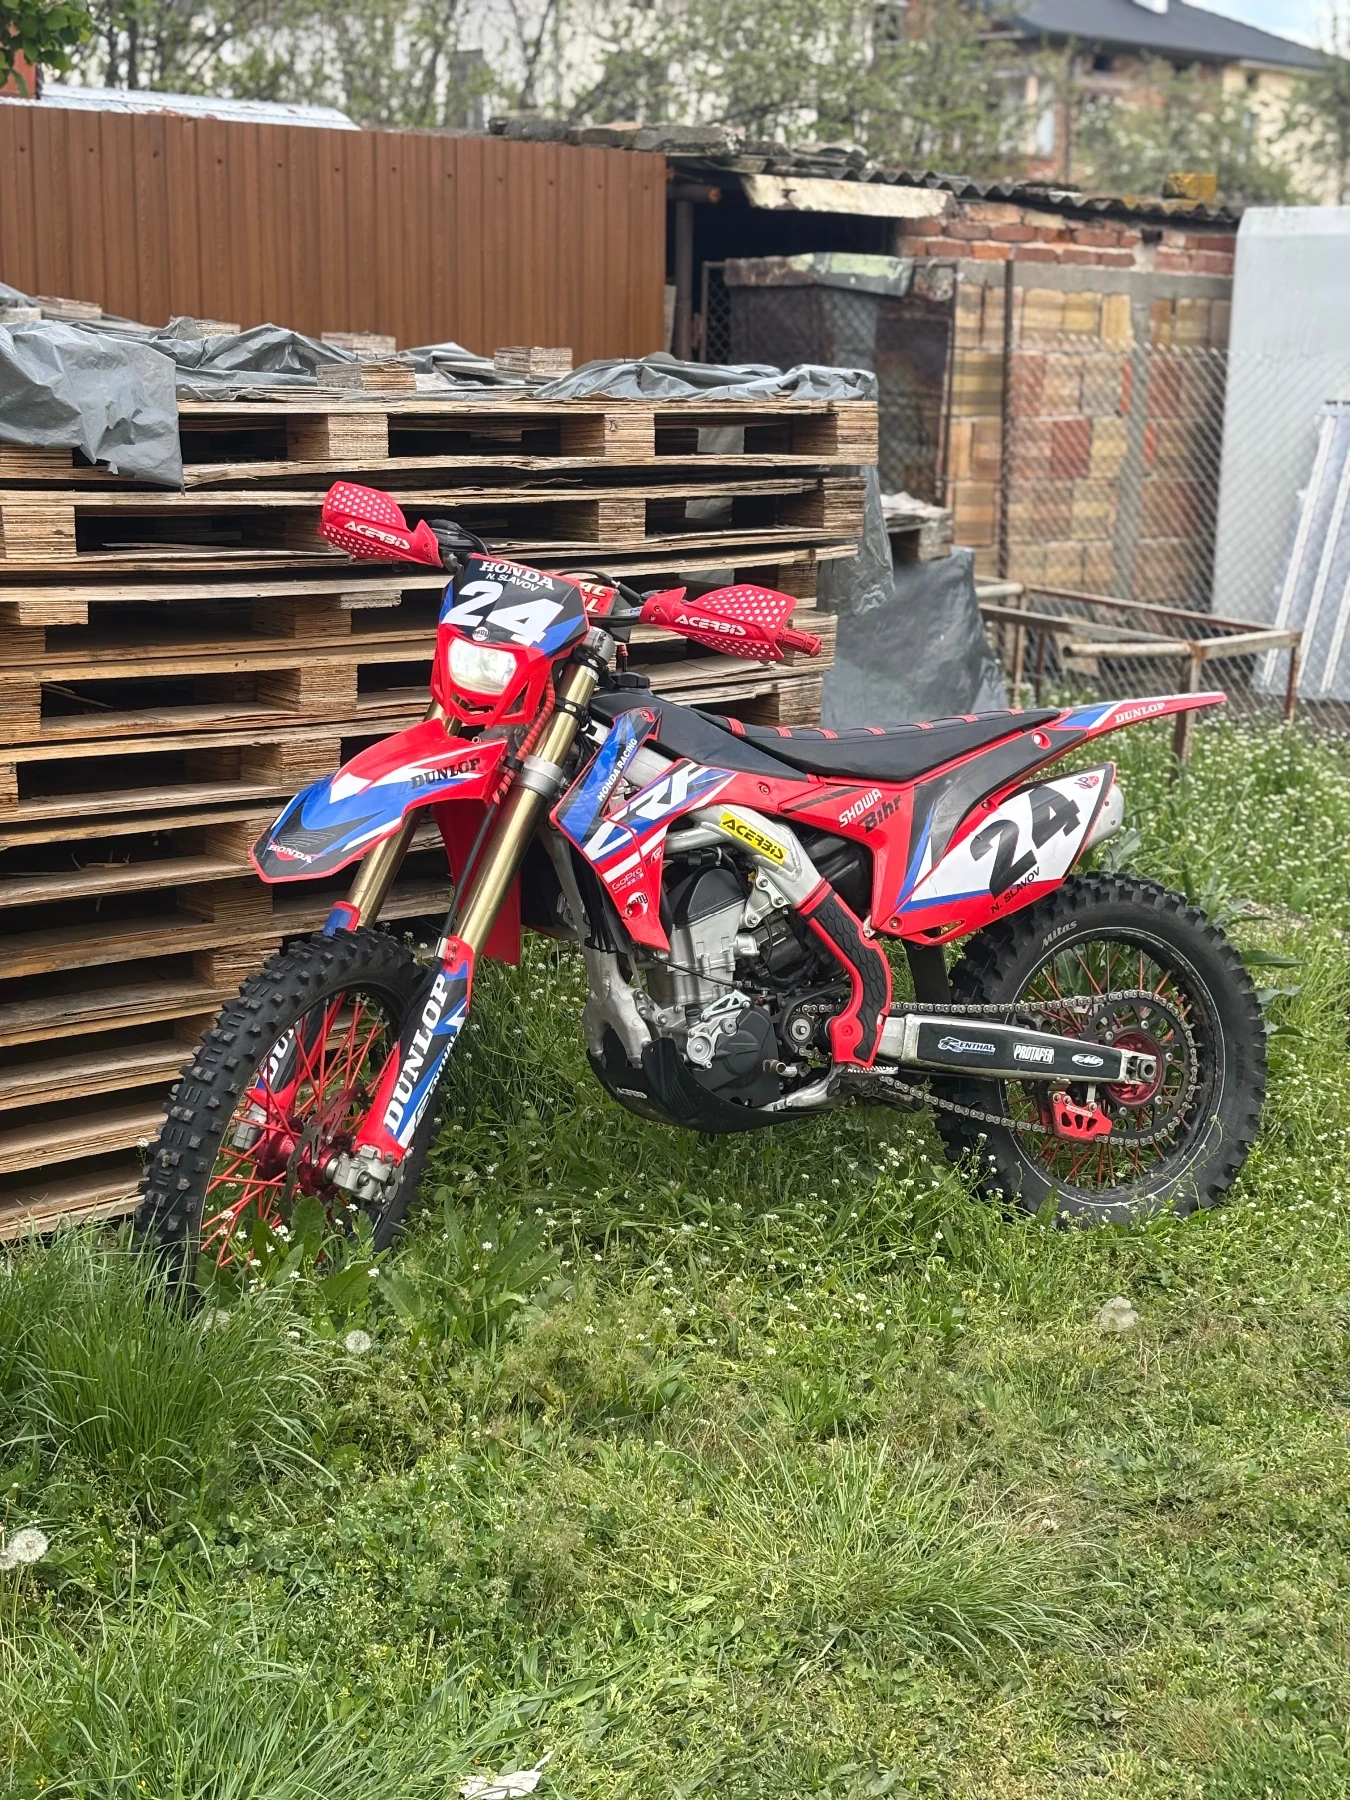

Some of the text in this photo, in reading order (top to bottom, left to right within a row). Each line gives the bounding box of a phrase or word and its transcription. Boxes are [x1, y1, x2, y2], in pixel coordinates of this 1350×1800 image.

[479, 561, 555, 591] HONDA
[486, 572, 541, 592] N. SLAVOV
[441, 580, 565, 648] 24
[1114, 702, 1166, 724] DUNLOP
[411, 758, 481, 790] DUNLOP
[597, 738, 638, 802] HONDA RACING
[838, 788, 883, 828] SHOWA
[857, 795, 901, 834] Bihr
[267, 843, 313, 864] HONDA
[970, 784, 1080, 899] 24
[612, 868, 643, 890] GoPro
[990, 866, 1040, 915] N. SLAVOV
[1041, 920, 1078, 950] Mitas
[383, 973, 448, 1135] DUNLOP
[1014, 1043, 1055, 1064] PROTAPER
[1071, 1054, 1104, 1067] FMF
